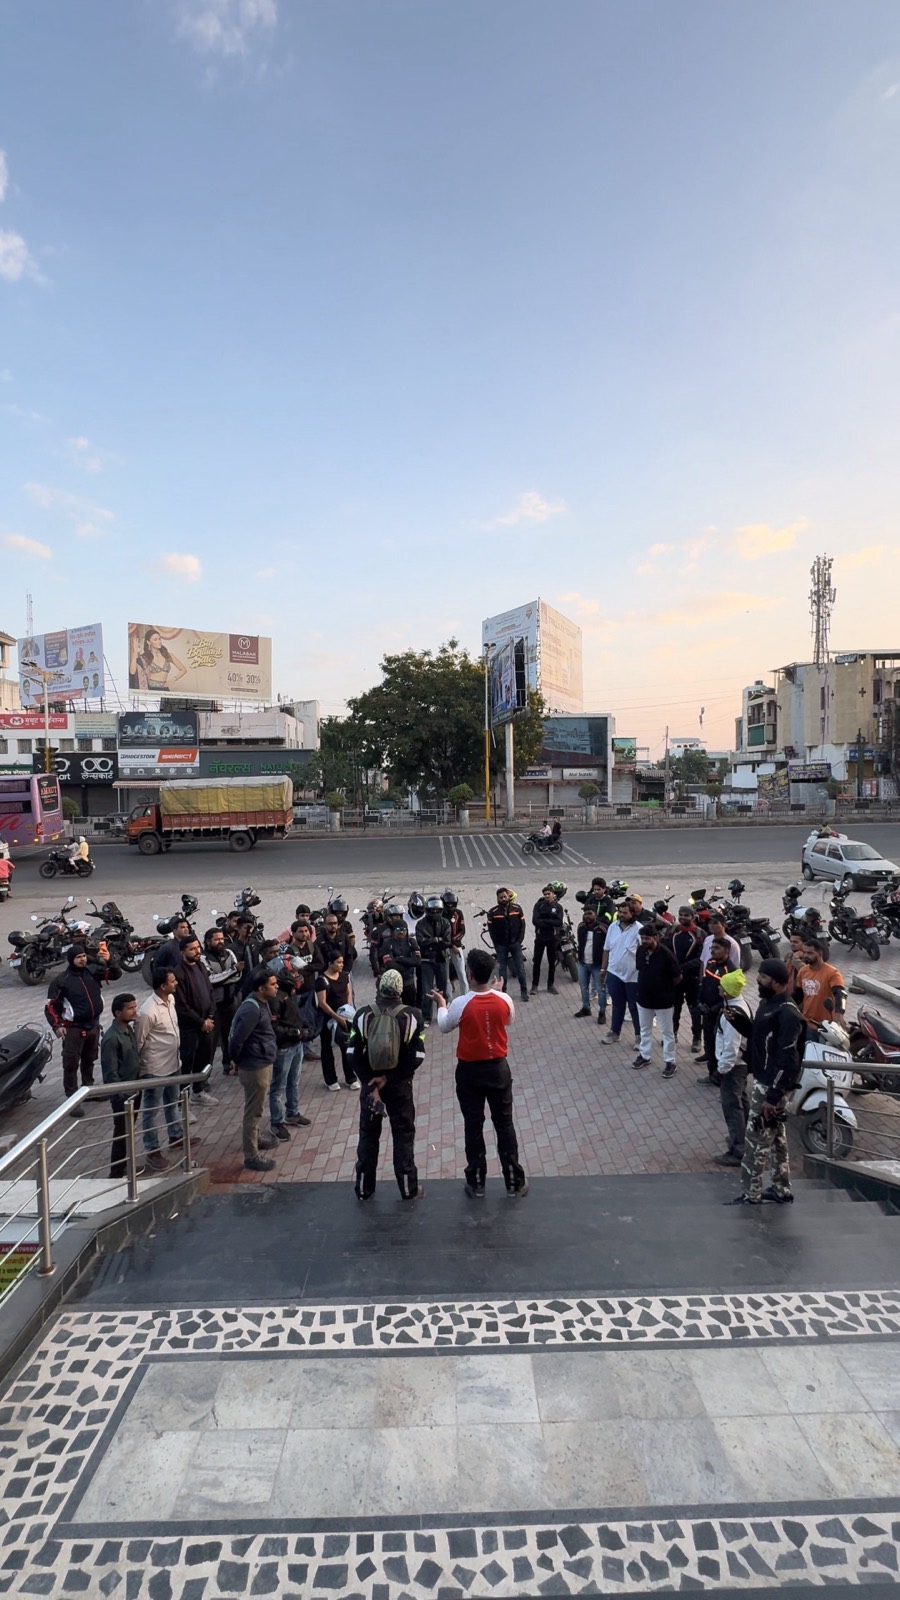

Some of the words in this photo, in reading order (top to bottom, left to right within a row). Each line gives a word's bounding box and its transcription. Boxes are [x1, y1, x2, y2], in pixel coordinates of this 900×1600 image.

[227, 672, 243, 682] 40%
[246, 674, 262, 685] 30%
[80, 770, 115, 780] लेन्सकार्ट
